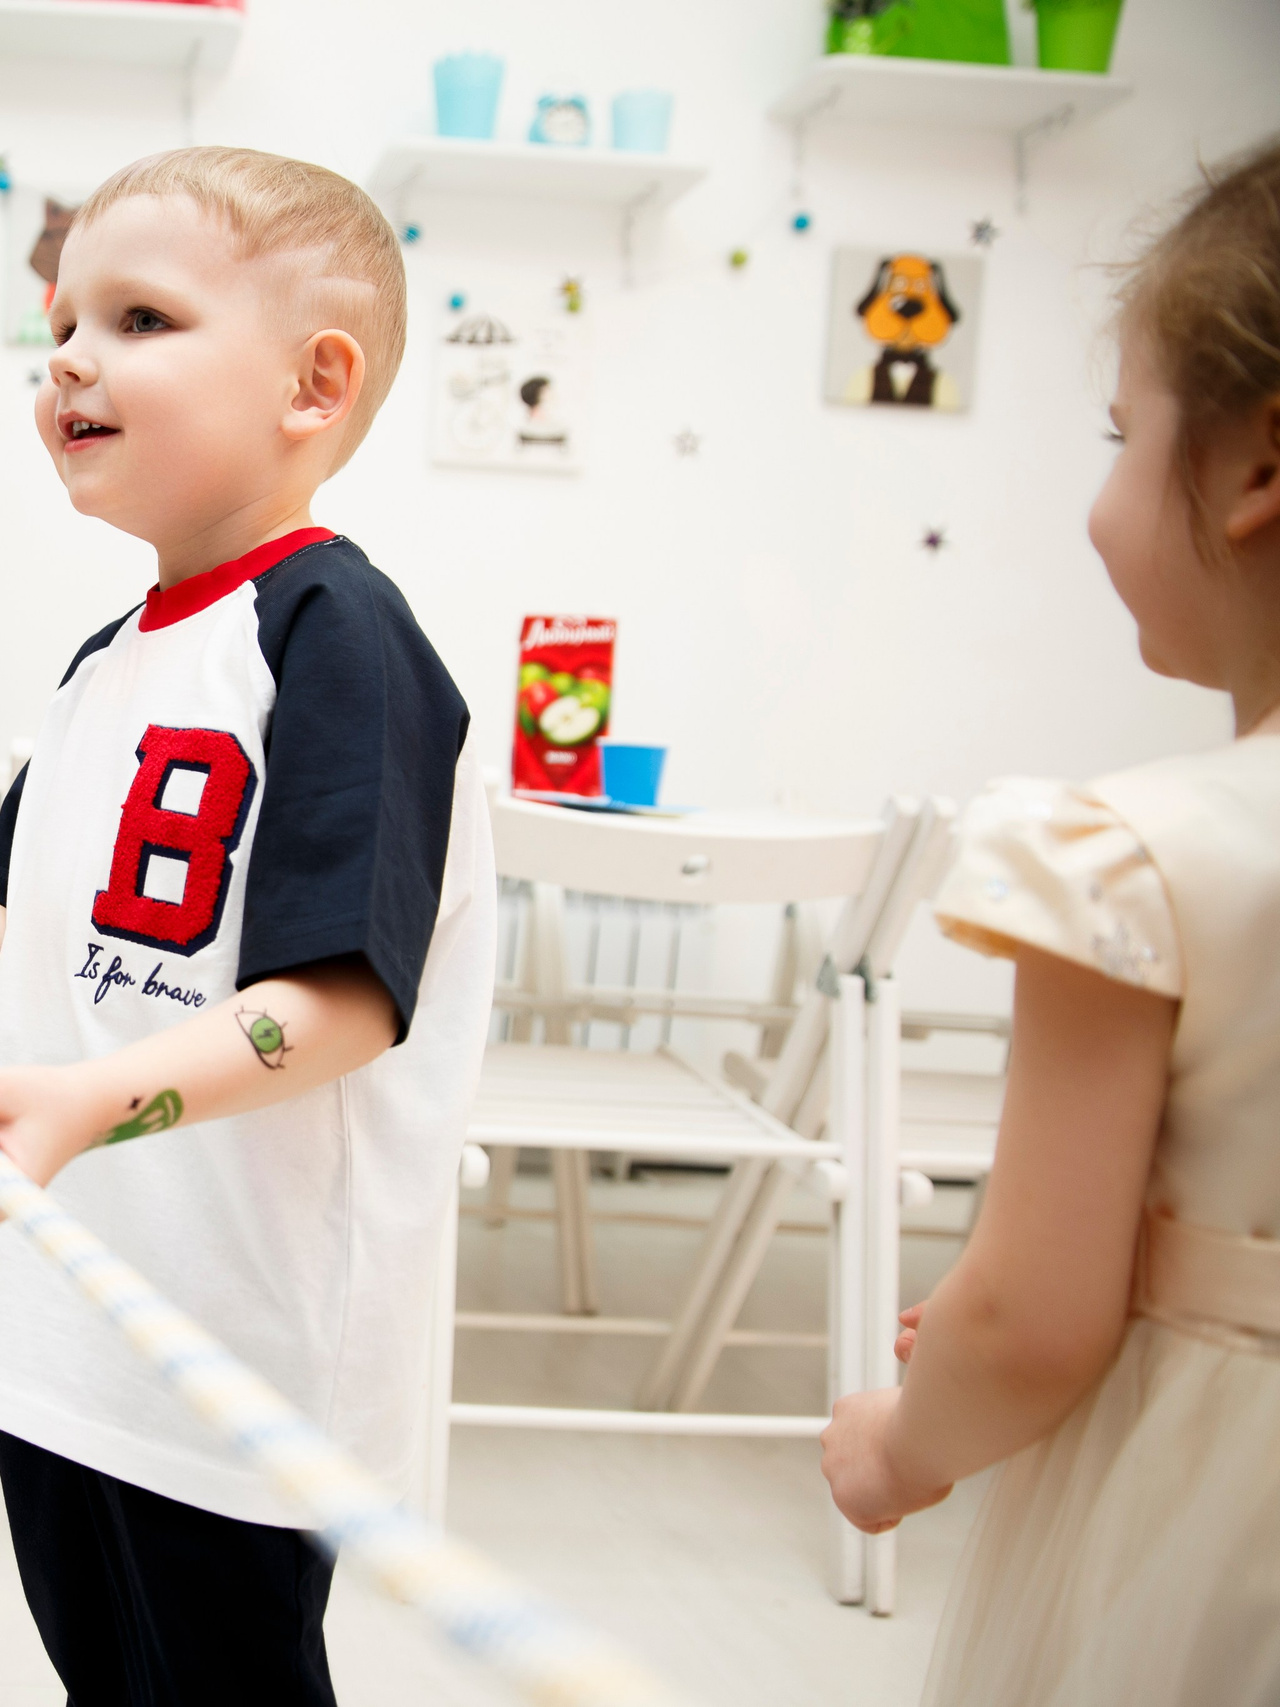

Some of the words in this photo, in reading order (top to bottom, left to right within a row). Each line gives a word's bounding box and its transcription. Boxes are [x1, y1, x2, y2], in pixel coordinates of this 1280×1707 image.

[91, 723, 258, 957] B
[74, 943, 104, 979] Is
[94, 956, 136, 1005] for
[142, 962, 207, 1008] brave
